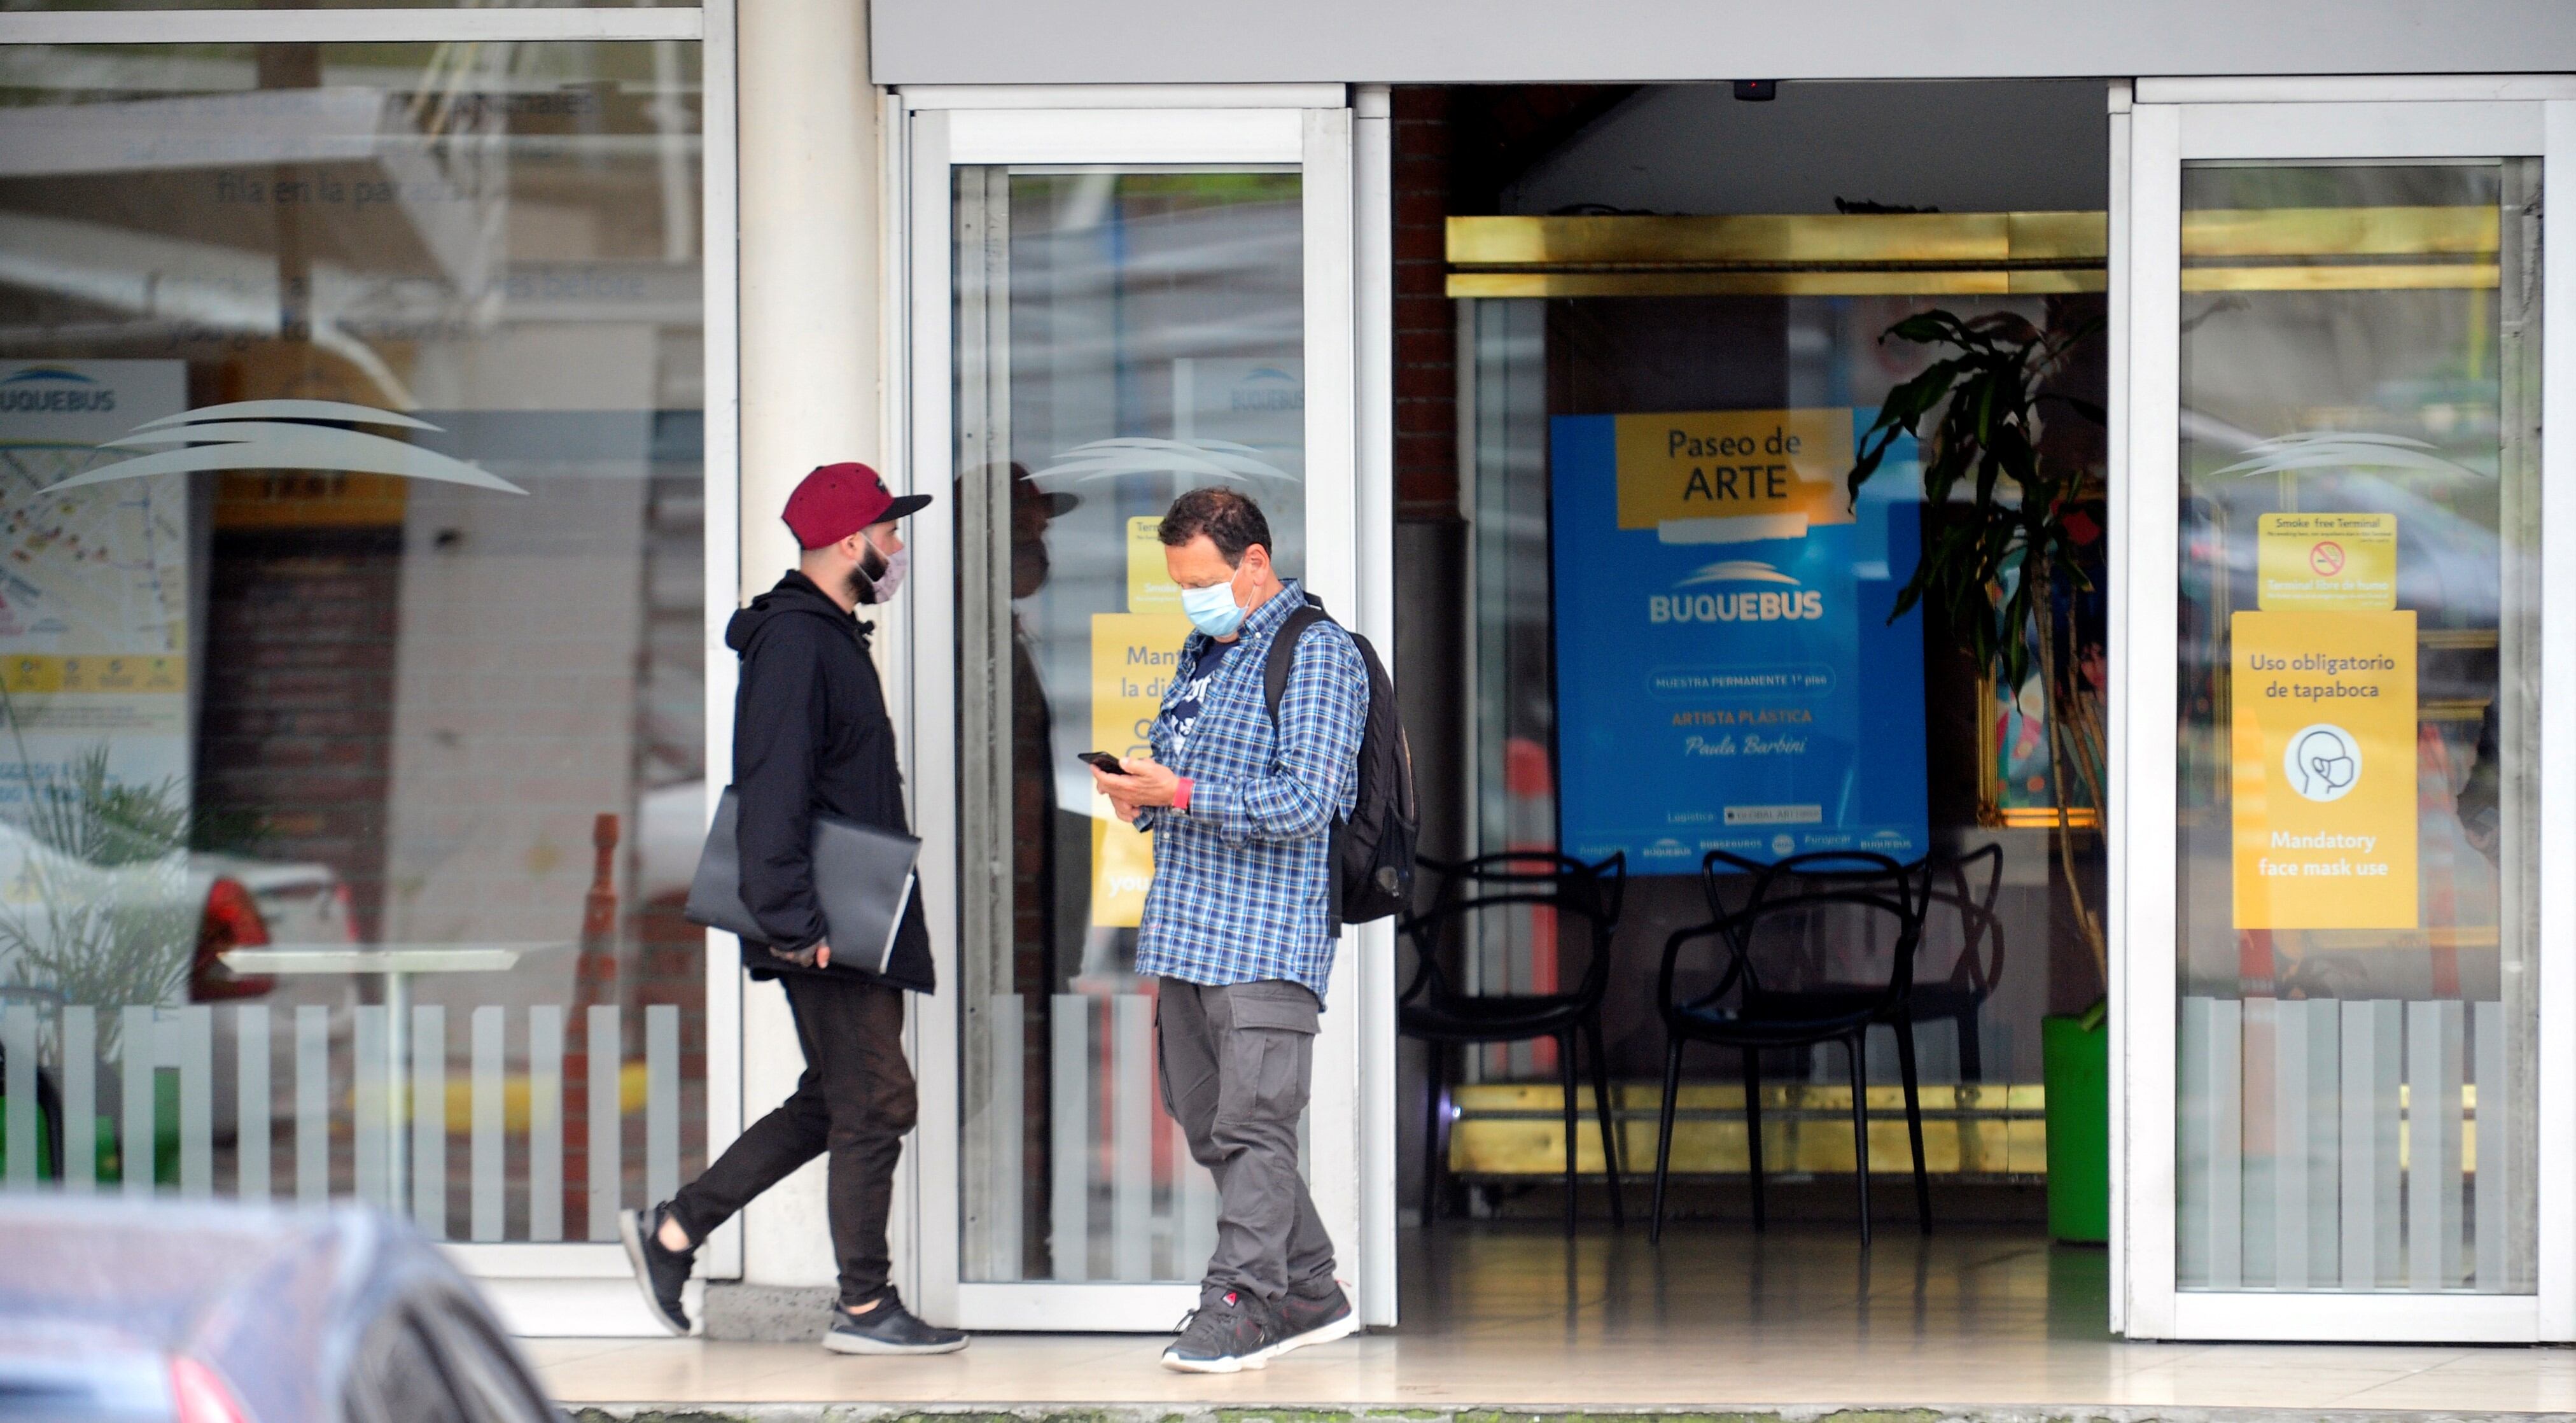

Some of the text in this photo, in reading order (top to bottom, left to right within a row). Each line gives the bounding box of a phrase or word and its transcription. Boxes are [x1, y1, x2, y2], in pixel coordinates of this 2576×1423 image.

[0, 389, 115, 412] UQUEBUS
[1669, 426, 1802, 458] Paseo de
[1683, 465, 1788, 501] ARTE
[2276, 517, 2381, 528] Smoke free Terminal
[2267, 579, 2389, 591] Terminal libre de humo
[1649, 589, 1823, 624] BUQUEBUS
[2250, 653, 2395, 675] Uso obligatorio
[1122, 677, 1139, 697] la
[1655, 677, 1709, 688] MUESTRA
[1711, 675, 1788, 687] PERMANENTE
[2266, 680, 2379, 702] de tapaboca
[1672, 708, 1814, 727] ARTISTA PLÁSTICA
[1684, 733, 1808, 757] Paula Barbini
[2271, 831, 2377, 853] Mandatory
[2258, 857, 2389, 876] face mask use
